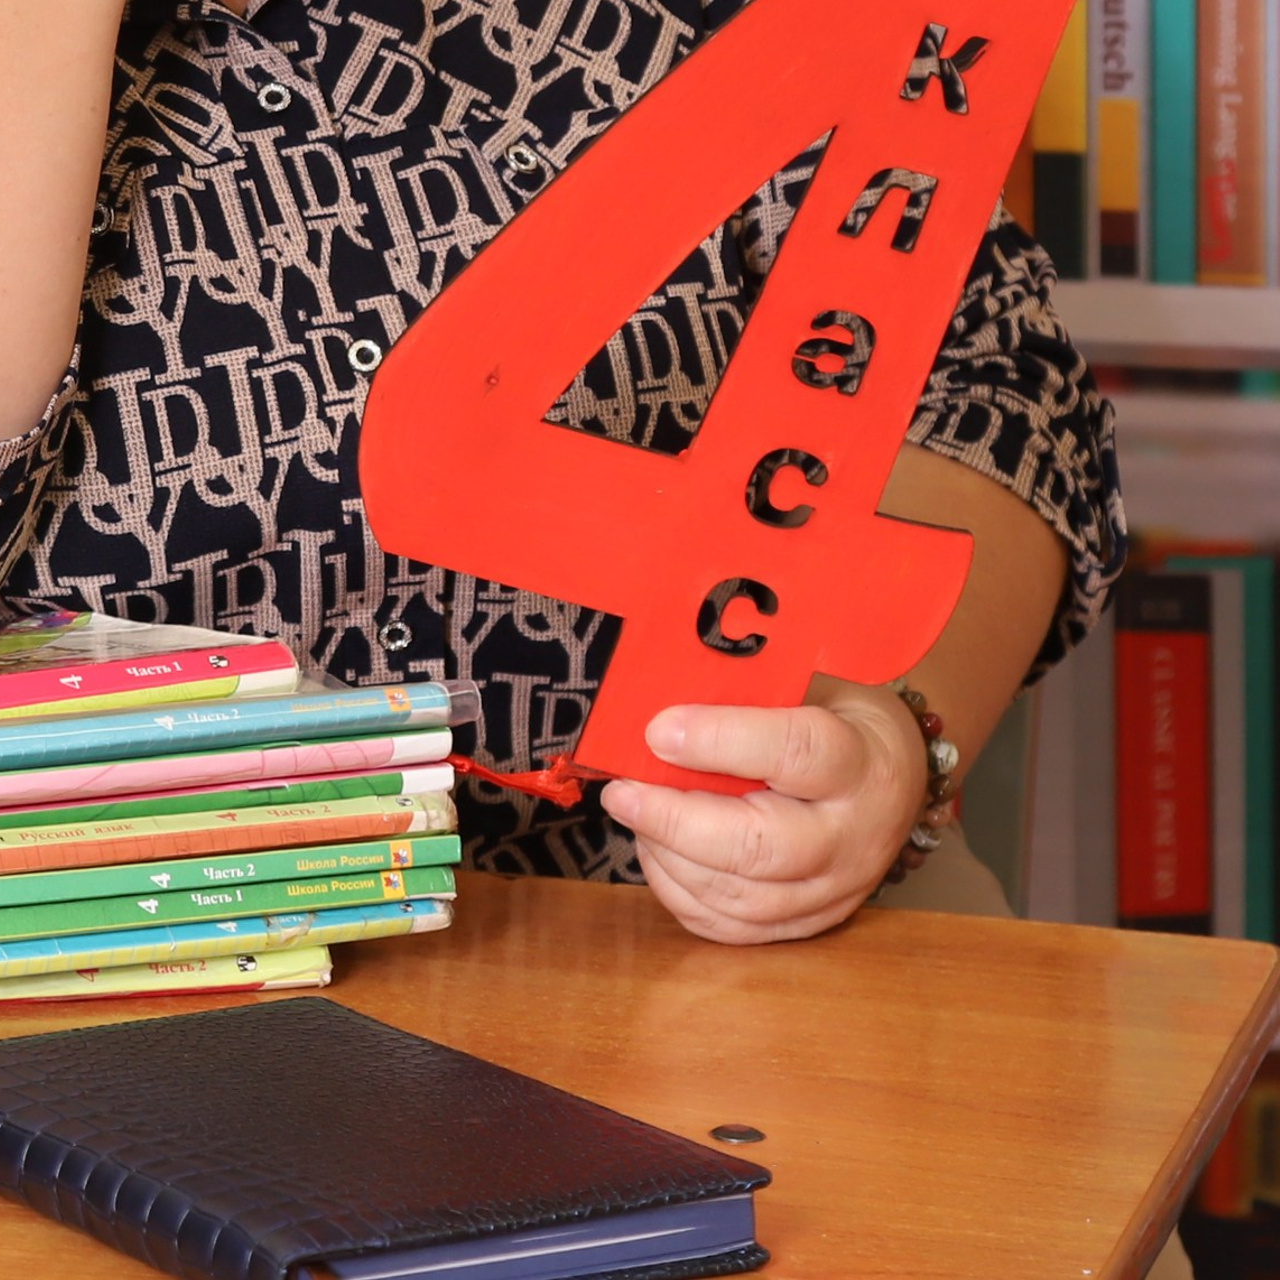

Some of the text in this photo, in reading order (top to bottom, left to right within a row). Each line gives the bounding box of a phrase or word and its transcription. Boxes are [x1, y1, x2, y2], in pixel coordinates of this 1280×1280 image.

[59, 674, 83, 689] 4
[125, 663, 171, 679] Часть
[173, 661, 183, 672] 1
[187, 711, 227, 725] Часть
[229, 708, 240, 720] 2
[19, 827, 86, 843] Русский
[93, 823, 135, 837] язык
[267, 806, 314, 819] Часть
[320, 804, 332, 814] 2
[150, 873, 172, 888] 4
[203, 864, 244, 881] Часть
[245, 863, 256, 877] 2
[297, 858, 337, 871] Школа
[340, 854, 384, 868] России
[138, 898, 159, 915] 4
[191, 892, 233, 907] Часть
[235, 889, 244, 902] 1
[287, 882, 328, 897] Школа
[331, 878, 375, 893] России
[148, 960, 195, 975] Часть
[196, 959, 207, 971] 2
